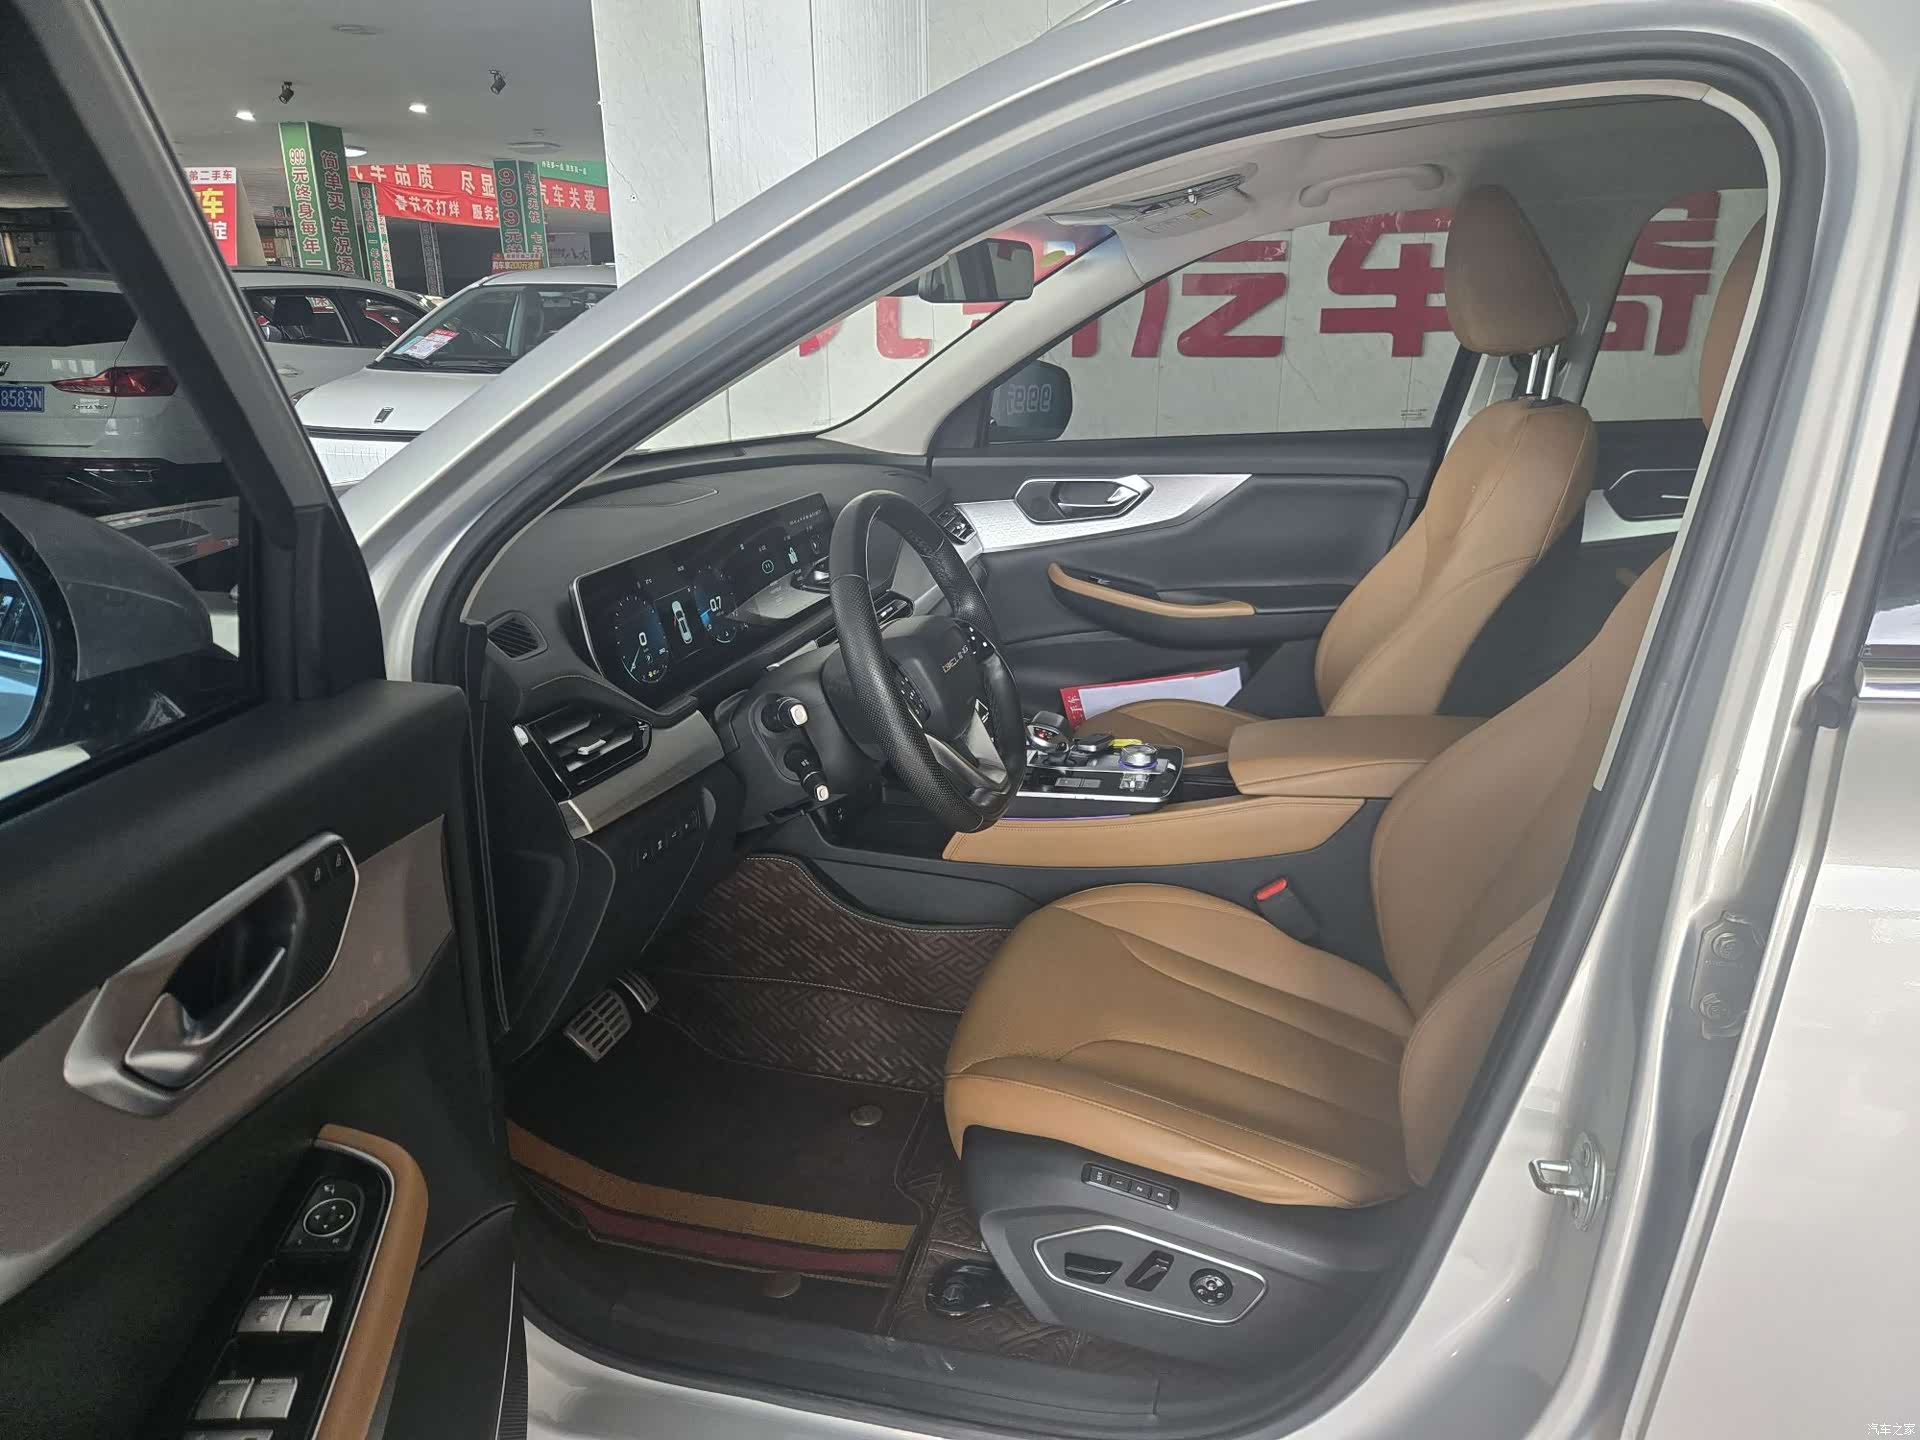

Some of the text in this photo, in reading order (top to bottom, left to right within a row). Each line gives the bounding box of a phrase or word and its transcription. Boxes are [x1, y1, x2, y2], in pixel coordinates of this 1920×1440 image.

[319, 150, 346, 212] 简单买
[394, 194, 500, 221] 春节不打烊 服务
